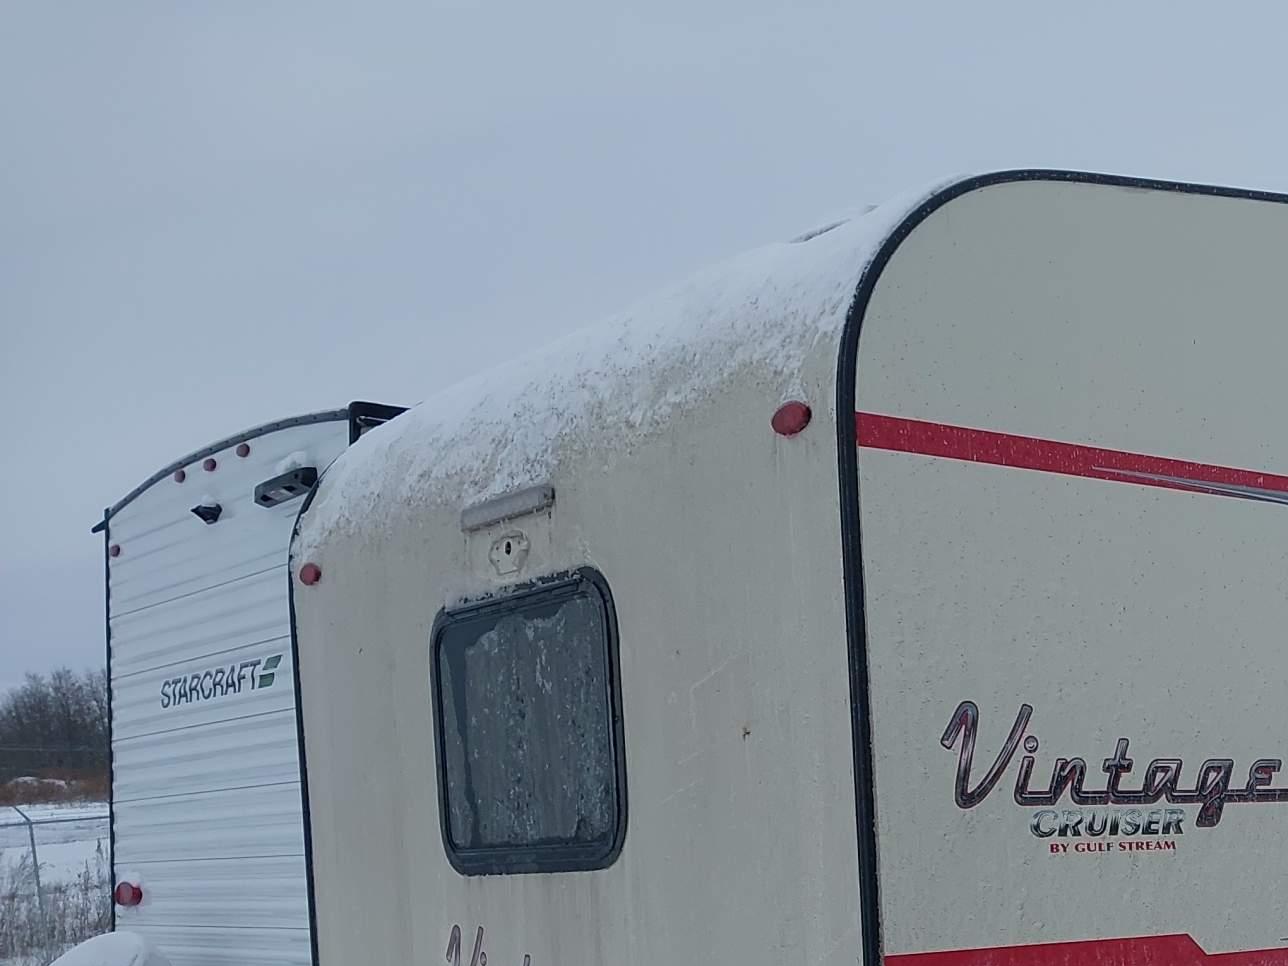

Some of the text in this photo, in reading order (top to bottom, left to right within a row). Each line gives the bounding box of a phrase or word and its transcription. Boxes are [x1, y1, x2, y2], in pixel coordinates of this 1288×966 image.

[161, 658, 261, 708] STARCRAFT
[1029, 808, 1186, 838] CRUISER
[1050, 839, 1177, 853] BY GULF STREAM
